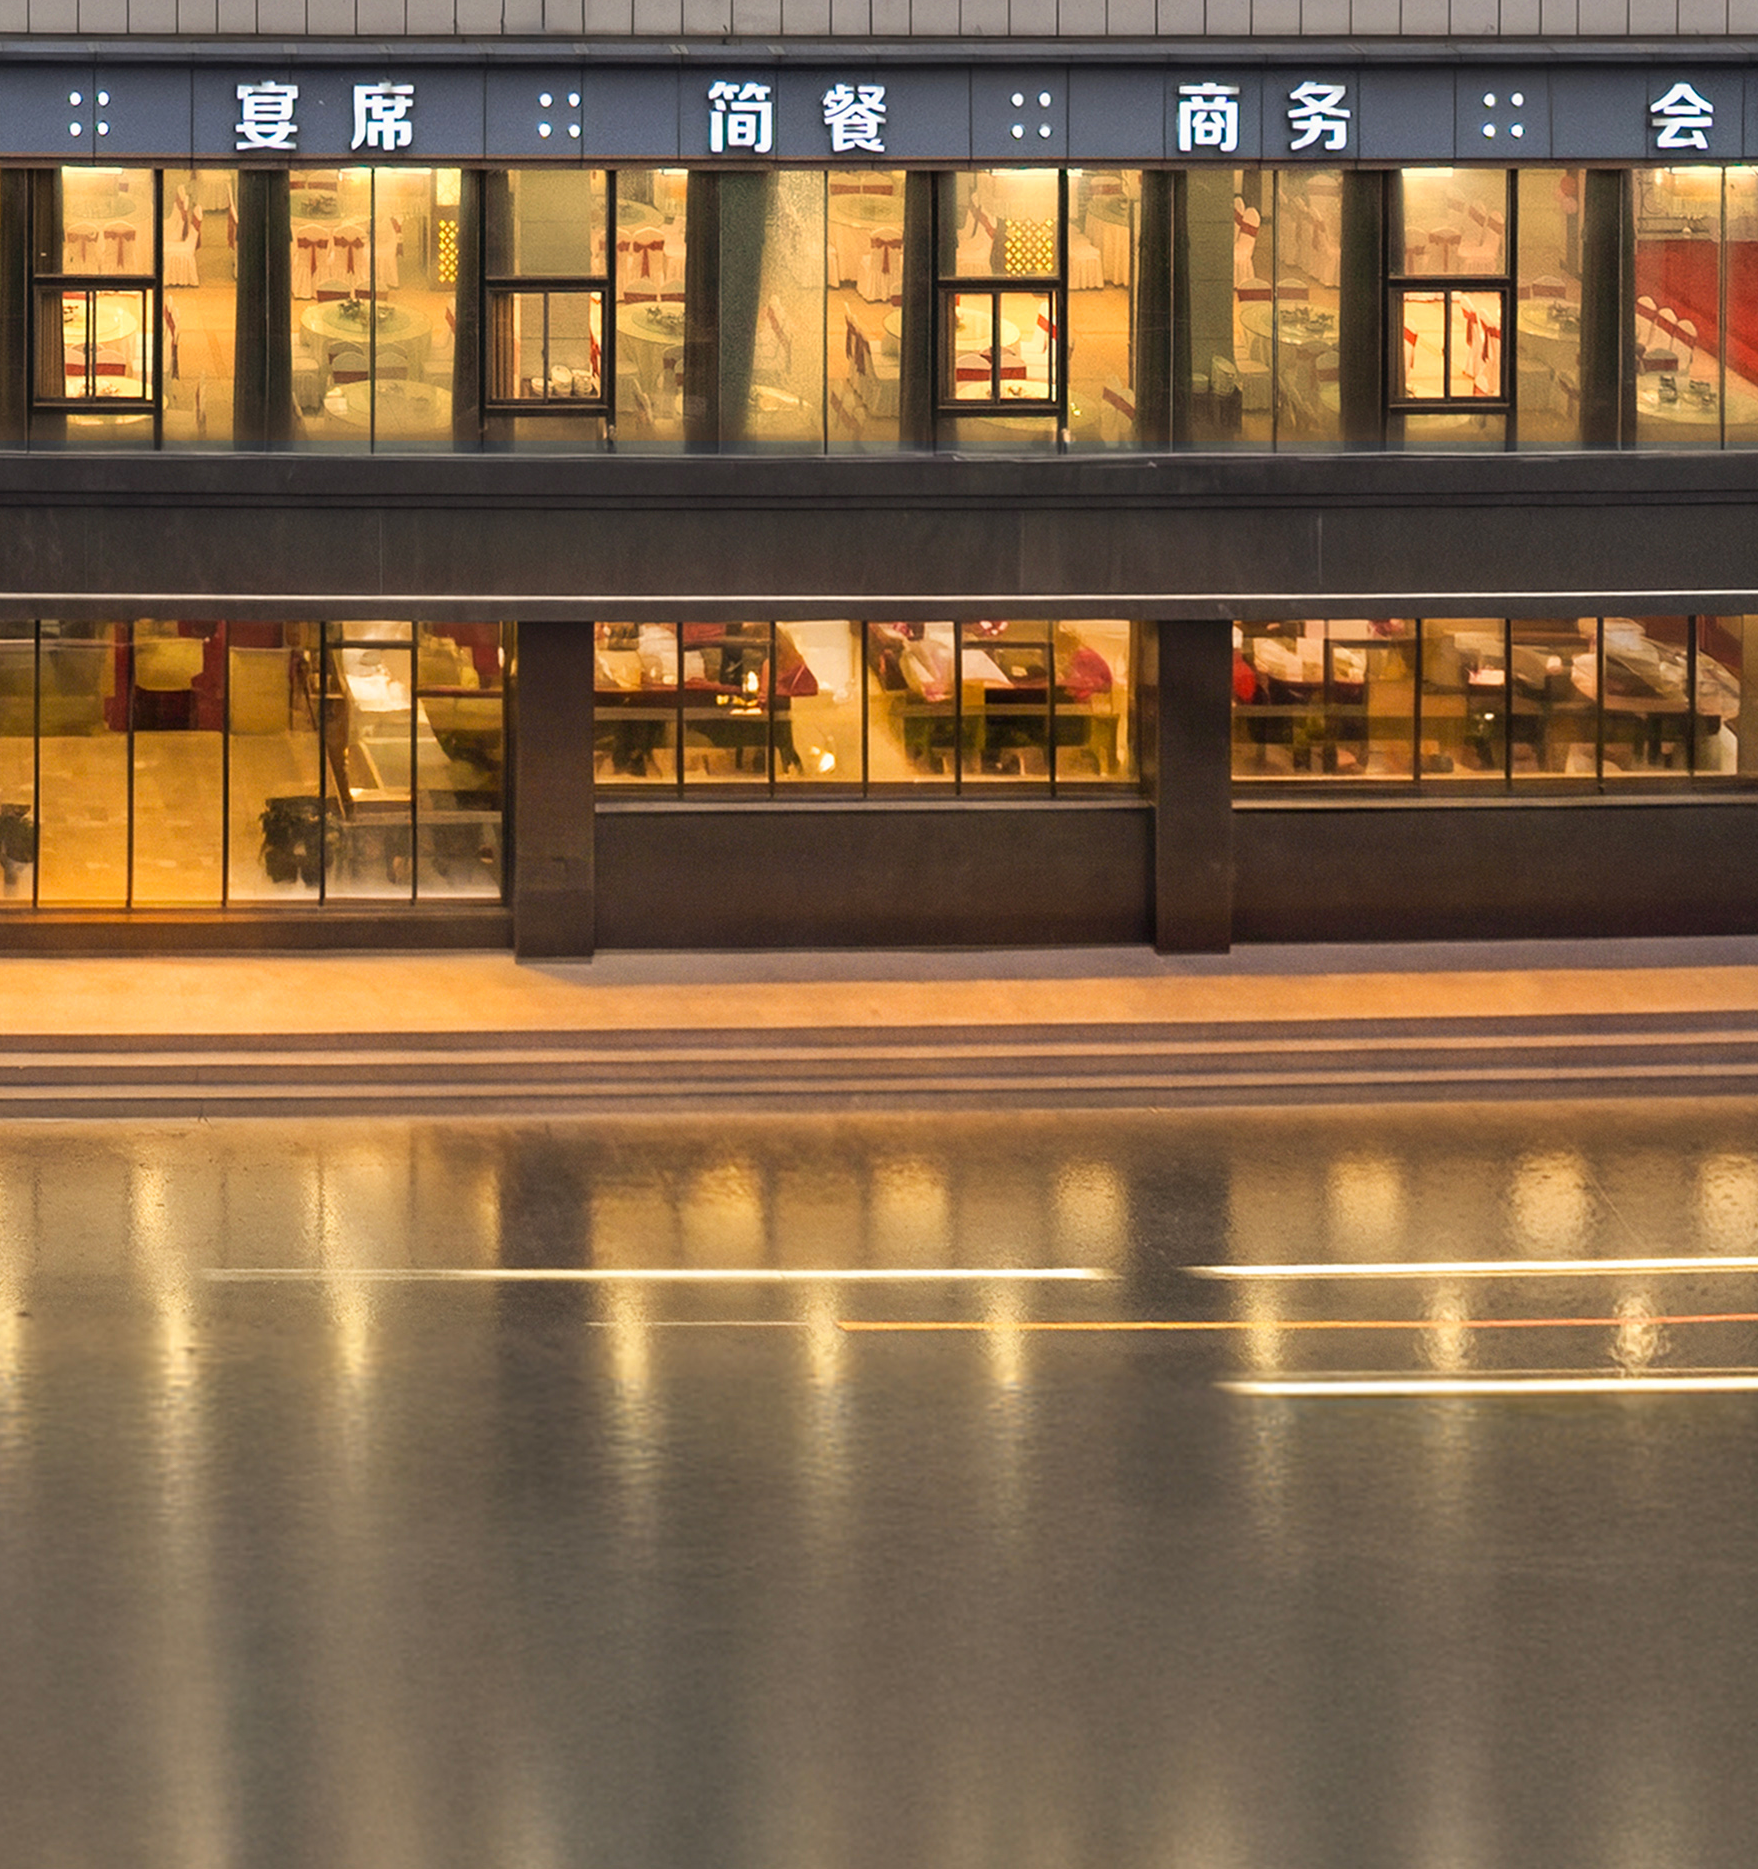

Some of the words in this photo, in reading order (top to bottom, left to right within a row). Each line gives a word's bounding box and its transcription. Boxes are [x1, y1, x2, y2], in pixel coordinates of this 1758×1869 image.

[235, 81, 414, 151] 宴席
[708, 81, 887, 153] 简餐
[1179, 81, 1351, 152] 商务
